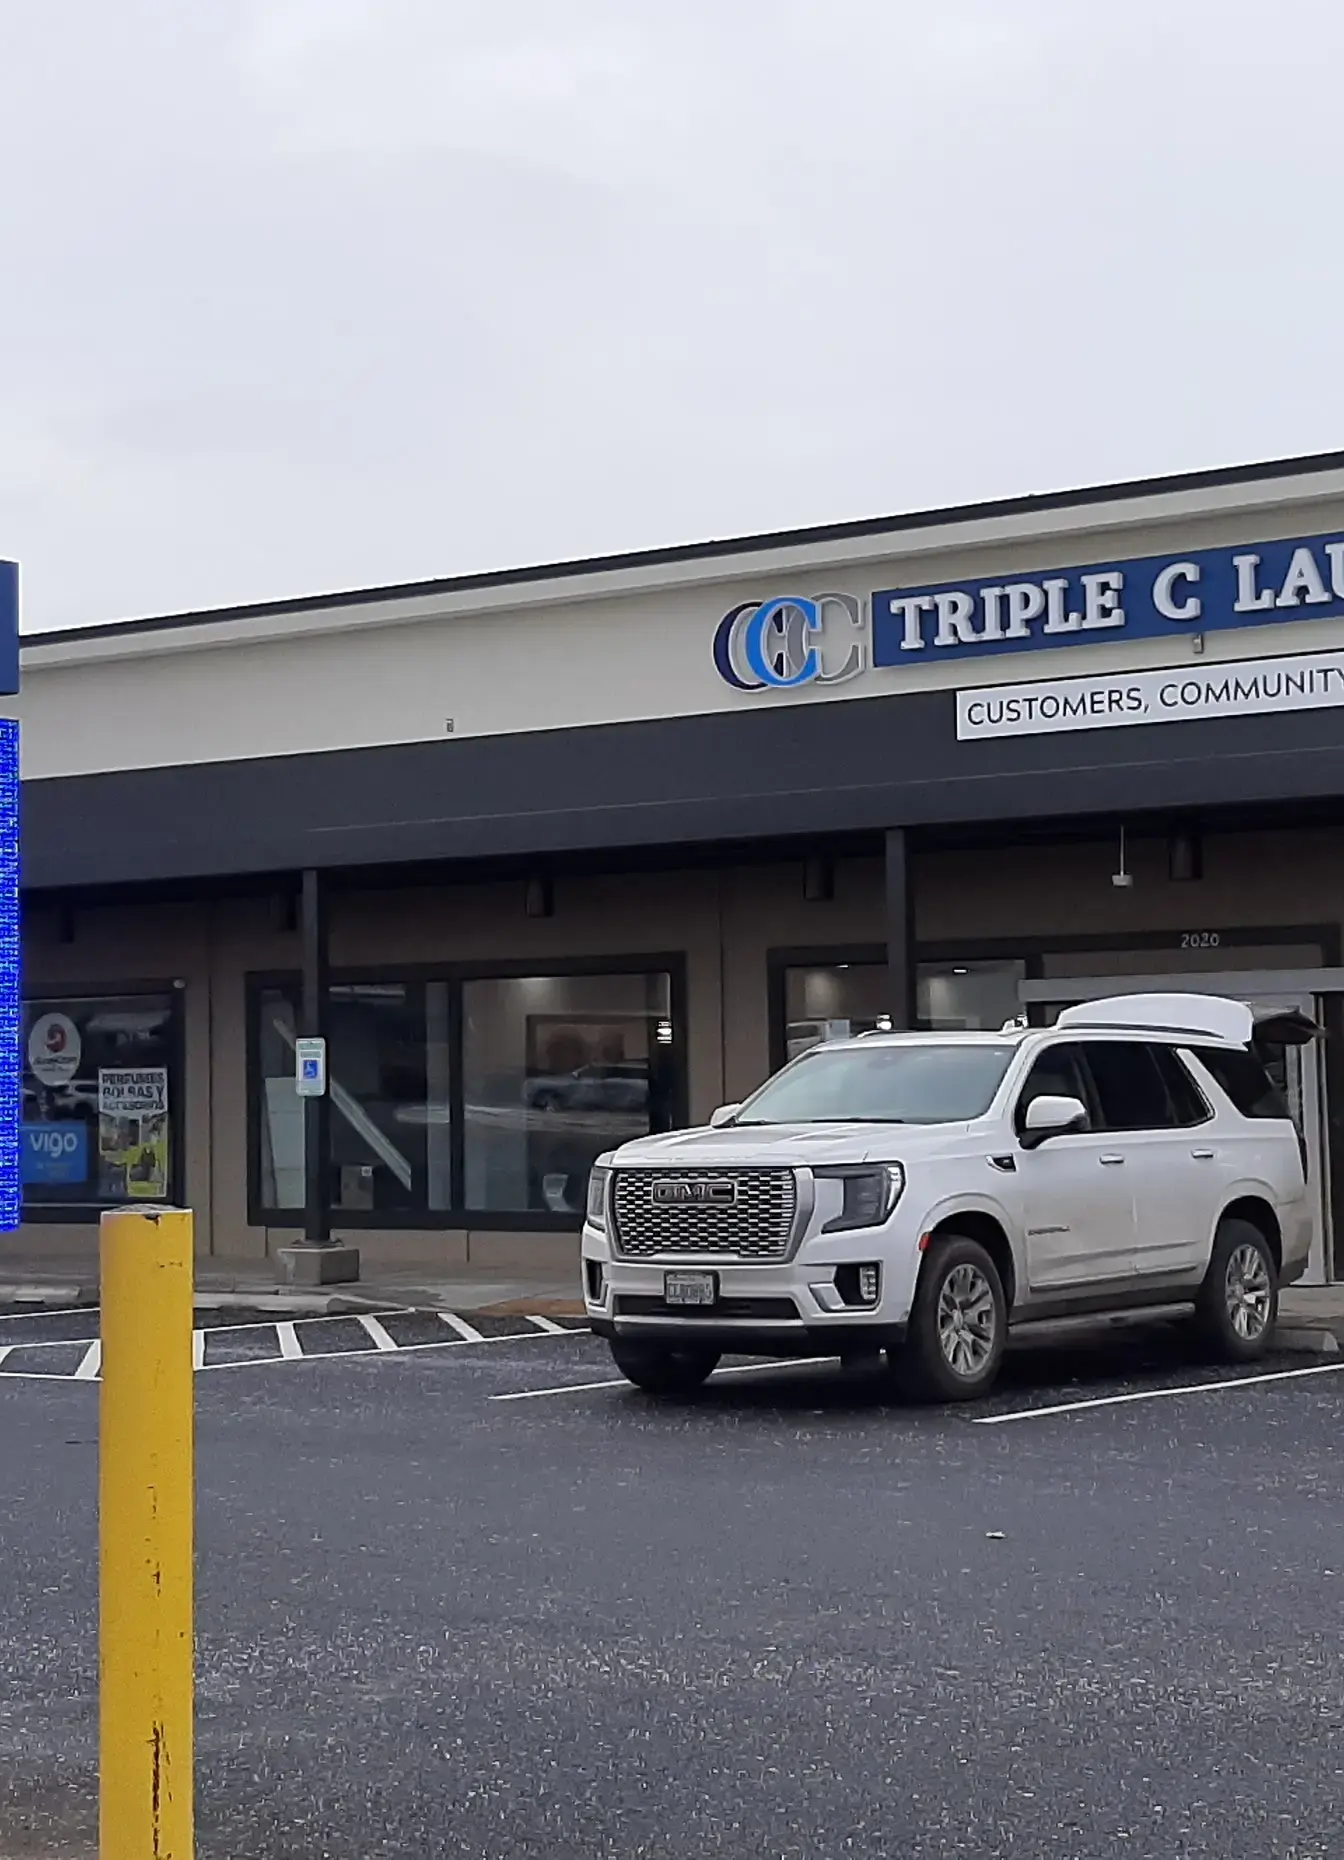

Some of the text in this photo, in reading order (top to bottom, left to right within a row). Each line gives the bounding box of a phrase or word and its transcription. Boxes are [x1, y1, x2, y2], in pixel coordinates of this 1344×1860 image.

[890, 571, 1126, 651] TRIPLE
[1153, 562, 1202, 620] C
[966, 686, 1151, 727] CUSTOMERS,
[1181, 932, 1220, 948] 2020
